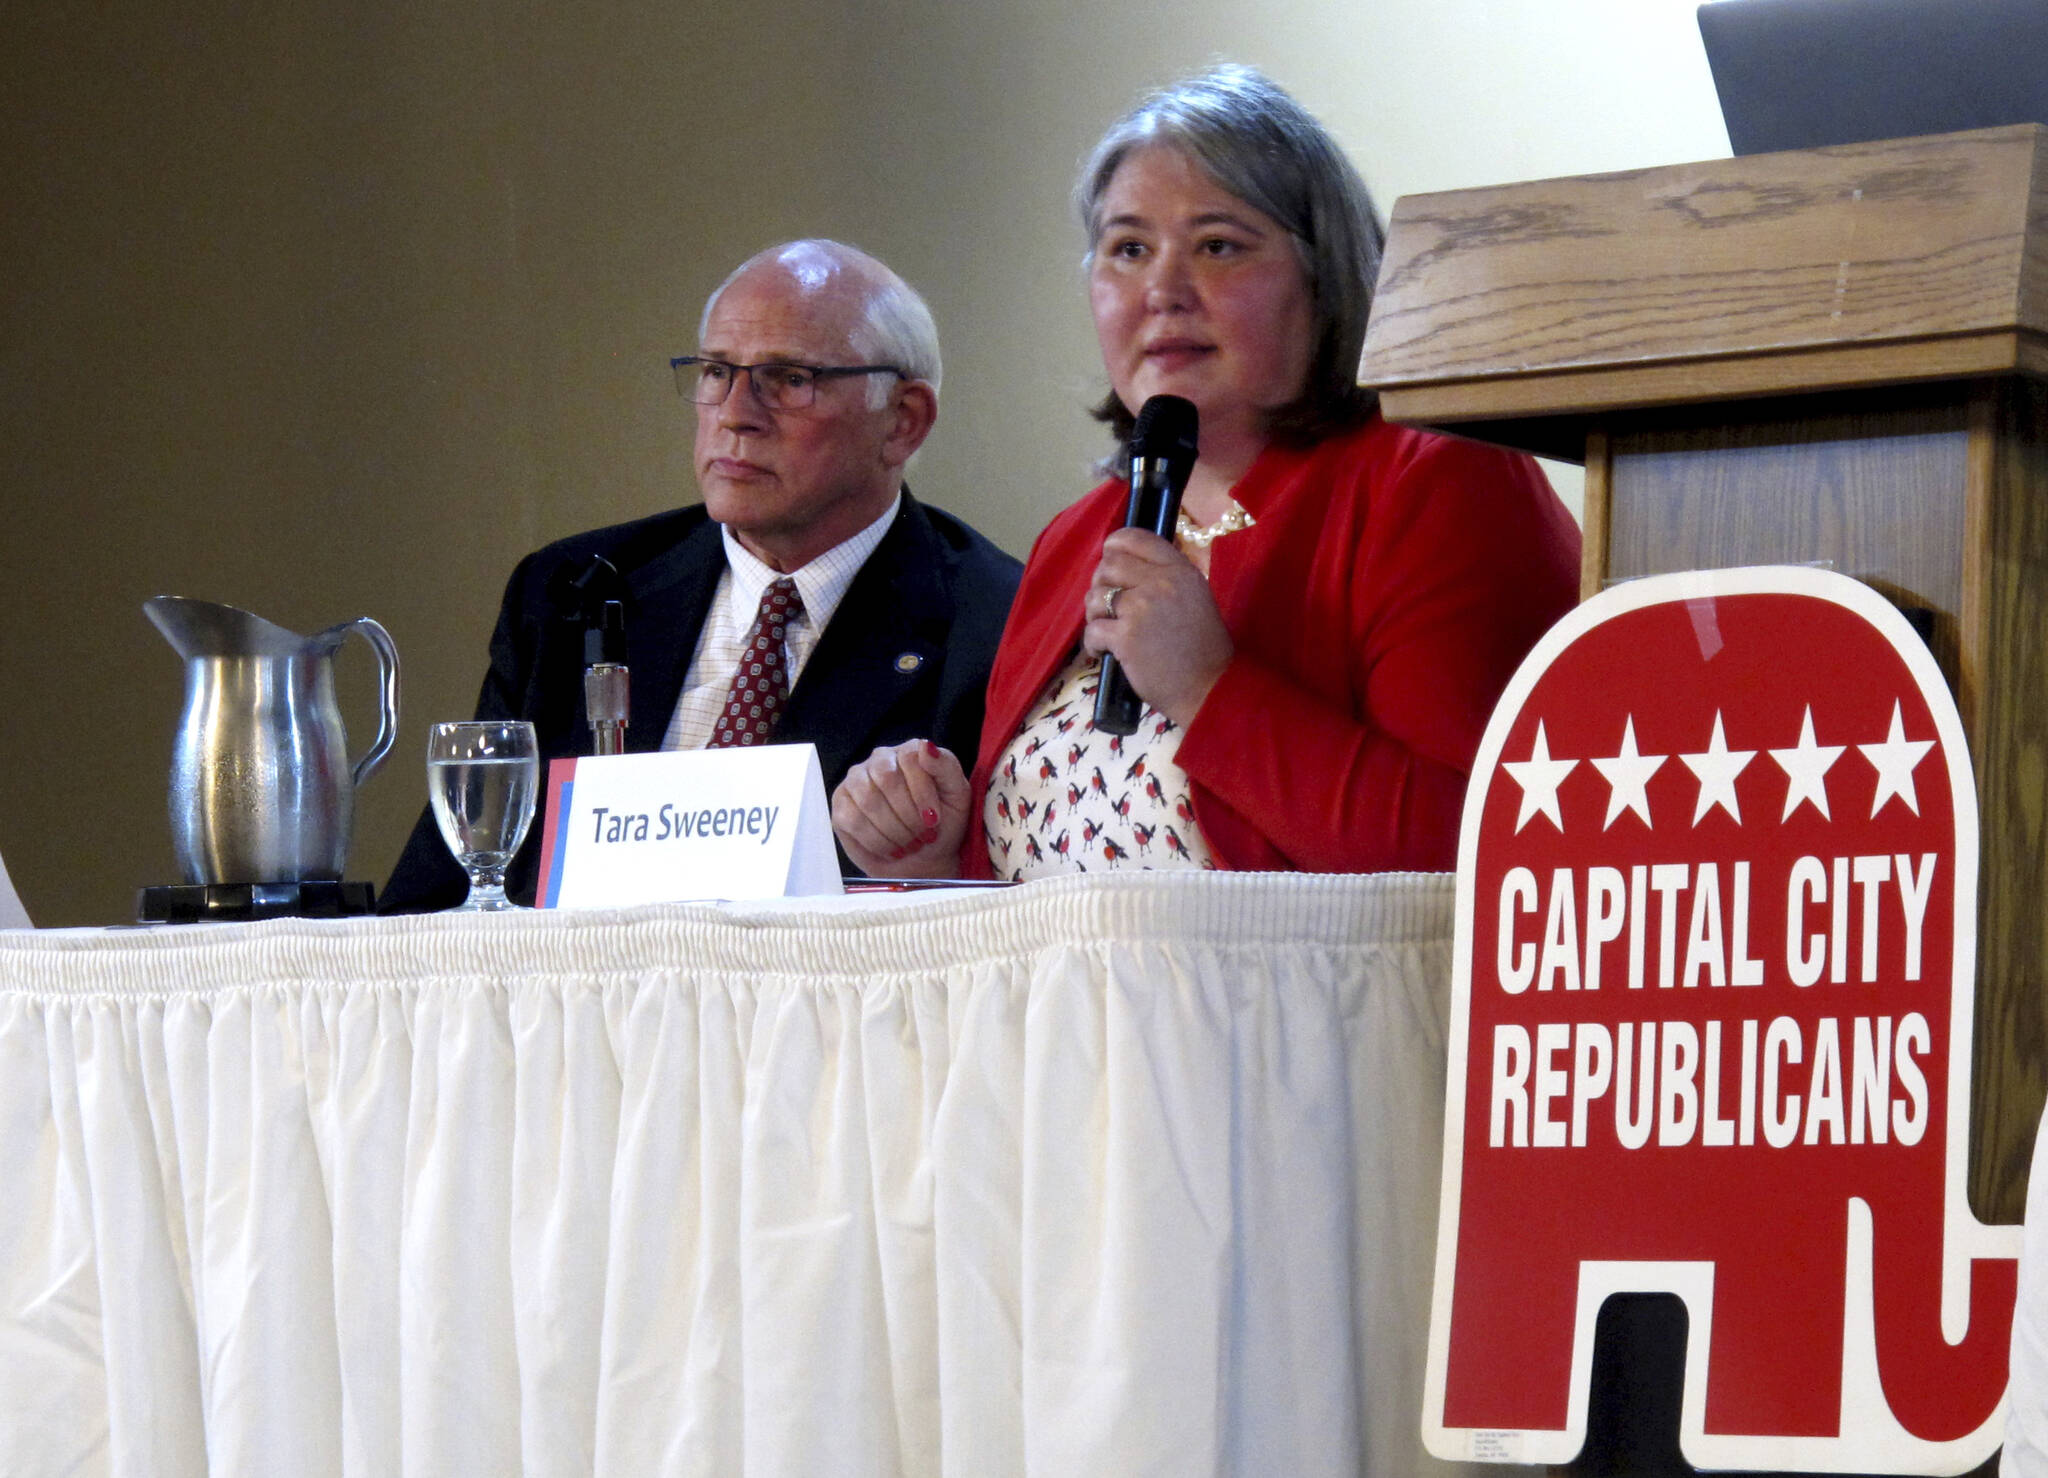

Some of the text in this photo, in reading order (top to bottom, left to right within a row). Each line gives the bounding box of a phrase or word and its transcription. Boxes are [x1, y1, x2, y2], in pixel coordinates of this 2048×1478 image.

[592, 803, 779, 844] Tara Sweeney
[1497, 853, 1937, 994] CAPITAL CITY
[1489, 1012, 1930, 1149] REPUBLICANS
